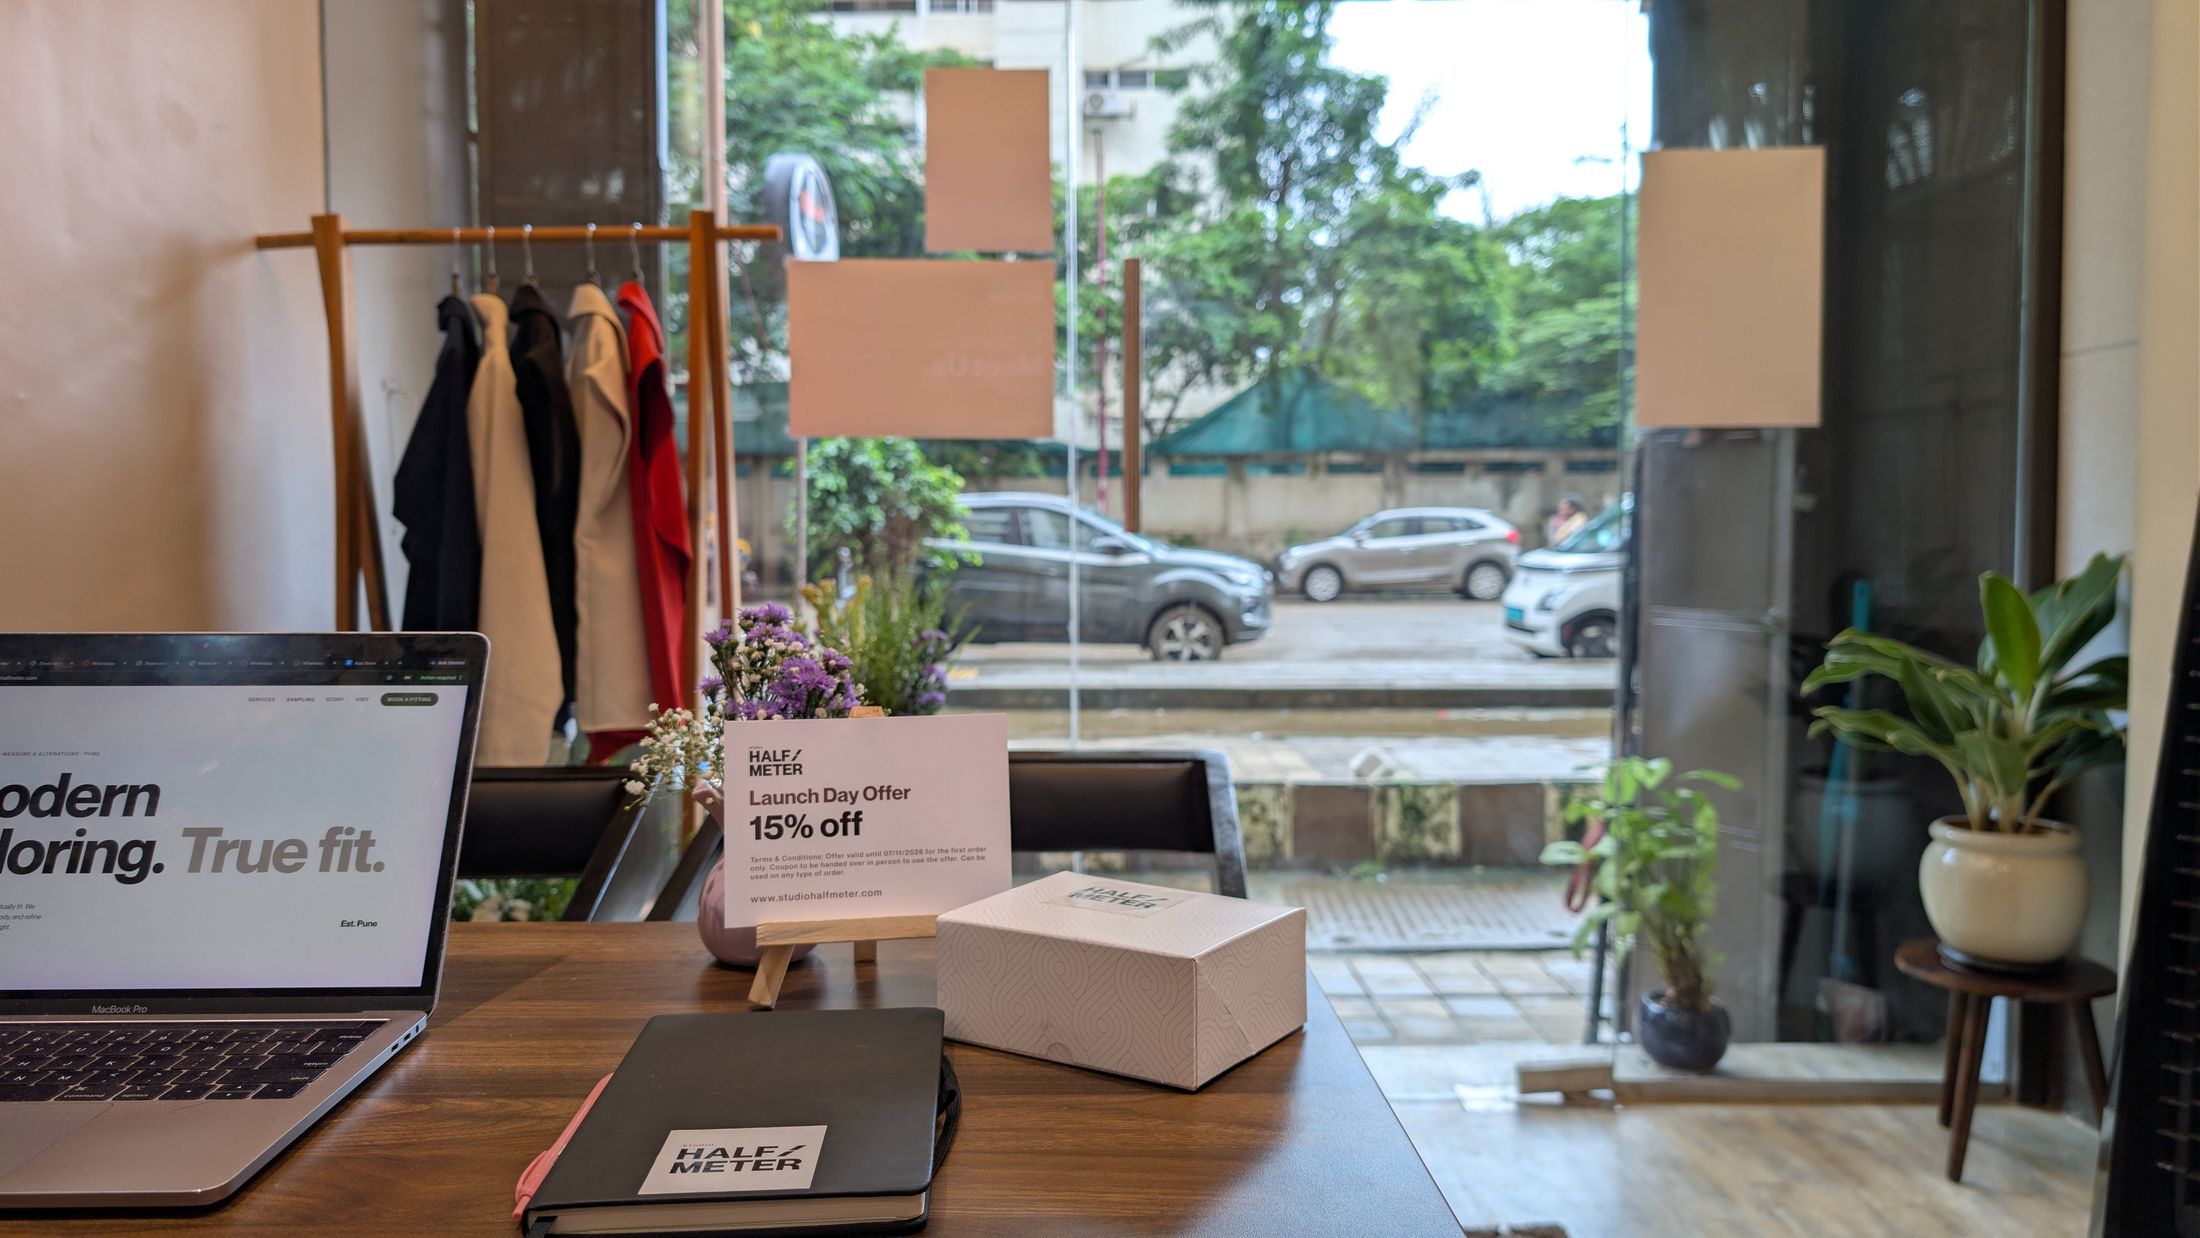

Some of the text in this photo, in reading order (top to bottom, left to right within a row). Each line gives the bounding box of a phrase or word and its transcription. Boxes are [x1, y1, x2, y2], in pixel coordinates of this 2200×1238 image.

[749, 763, 803, 777] METER
[750, 785, 911, 806] Launch Day Offer
[750, 810, 863, 840] 15% off
[181, 827, 309, 874] True
[318, 826, 385, 873] fit.
[846, 851, 864, 859] valid
[865, 850, 882, 858] until
[951, 846, 966, 854] first
[769, 863, 798, 871] Coupon
[875, 858, 901, 866] person
[750, 872, 768, 880] used
[796, 871, 813, 879] type
[750, 888, 883, 903] www.studiohalfmeter.com
[1069, 892, 1157, 909] METER
[341, 919, 378, 928] Est. Pune
[91, 1004, 148, 1014] MacBook Pro
[669, 1158, 803, 1174] METER
